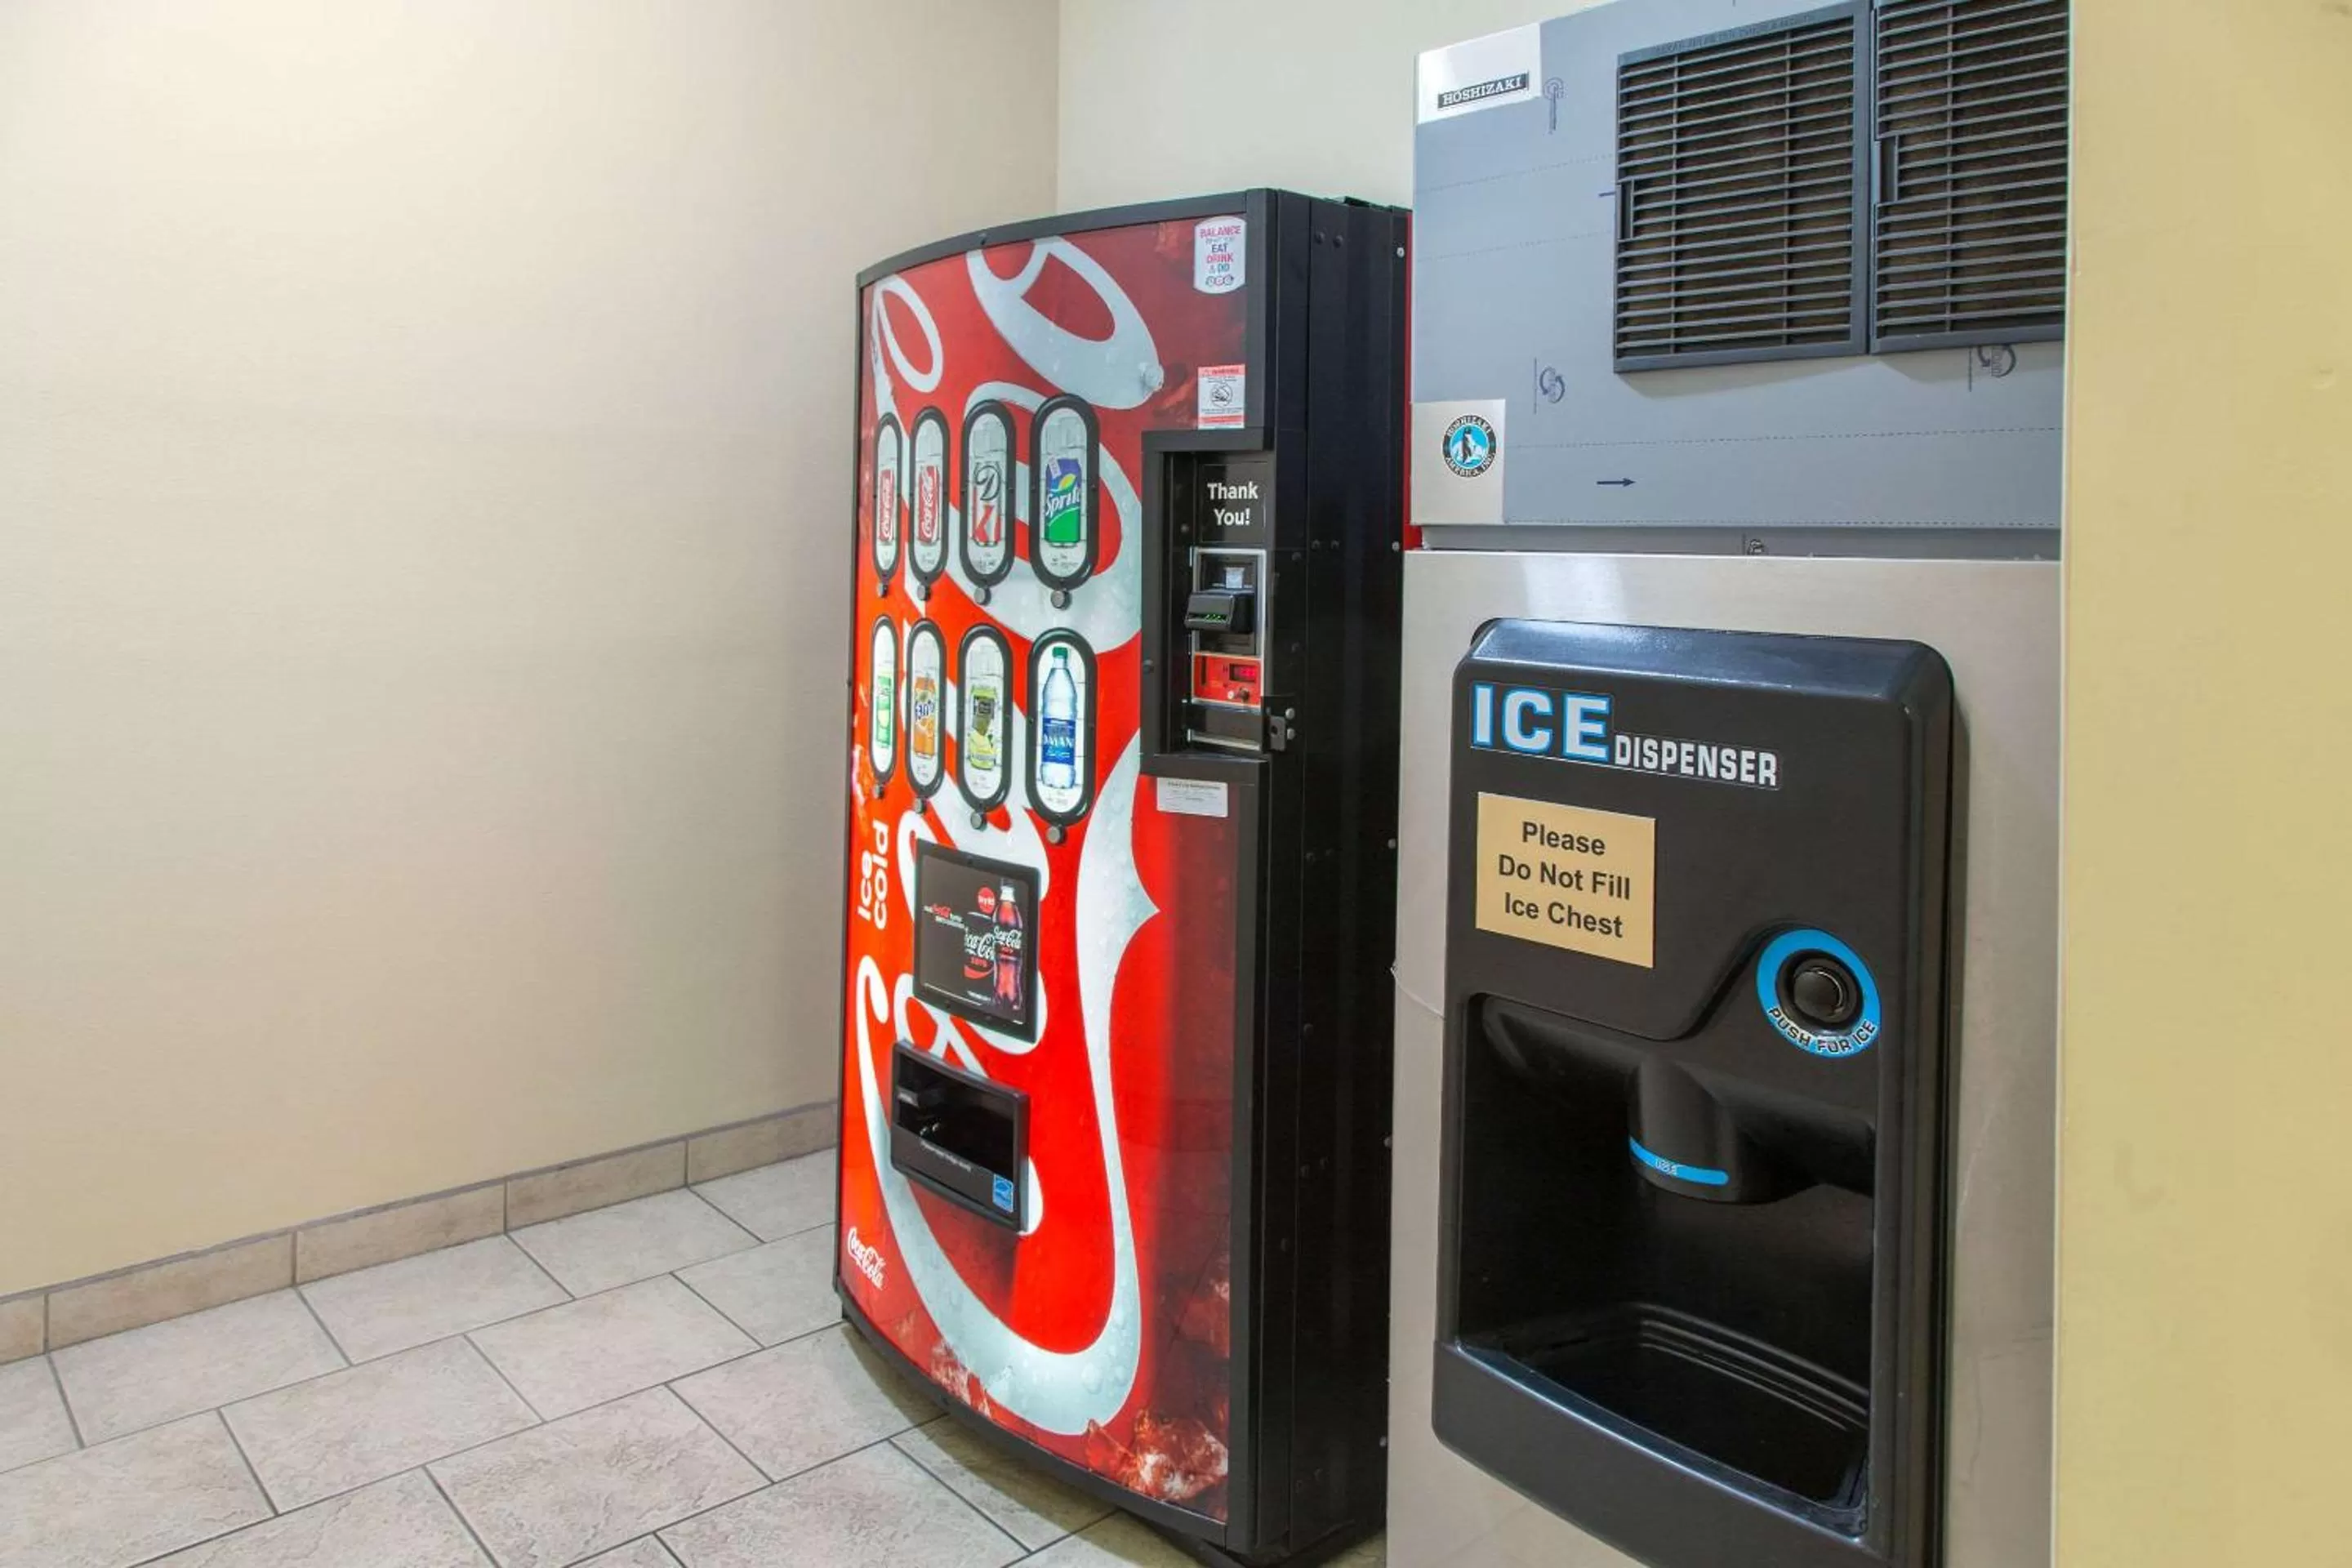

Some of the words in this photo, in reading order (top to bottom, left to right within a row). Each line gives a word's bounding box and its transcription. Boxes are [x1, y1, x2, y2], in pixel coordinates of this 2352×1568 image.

[1442, 76, 1522, 106] HOSHIZAKI
[1200, 225, 1241, 238] BALANCE
[1207, 253, 1234, 264] DRINK
[1211, 243, 1228, 253] EAT
[1207, 481, 1258, 500] Thank
[1214, 508, 1251, 526] You!
[1472, 682, 1613, 762] ICE
[1615, 734, 1779, 786] DISPENSER
[1521, 821, 1606, 855] Please
[873, 819, 889, 929] cold
[1499, 854, 1531, 880] Do
[1540, 862, 1584, 891] Not
[1592, 871, 1630, 900] Fill
[1504, 892, 1539, 920] Ice
[1548, 902, 1623, 938] Chest
[1768, 1007, 1811, 1046] PUSH
[1817, 1038, 1852, 1054] FOR
[1852, 1019, 1876, 1045] ICE
